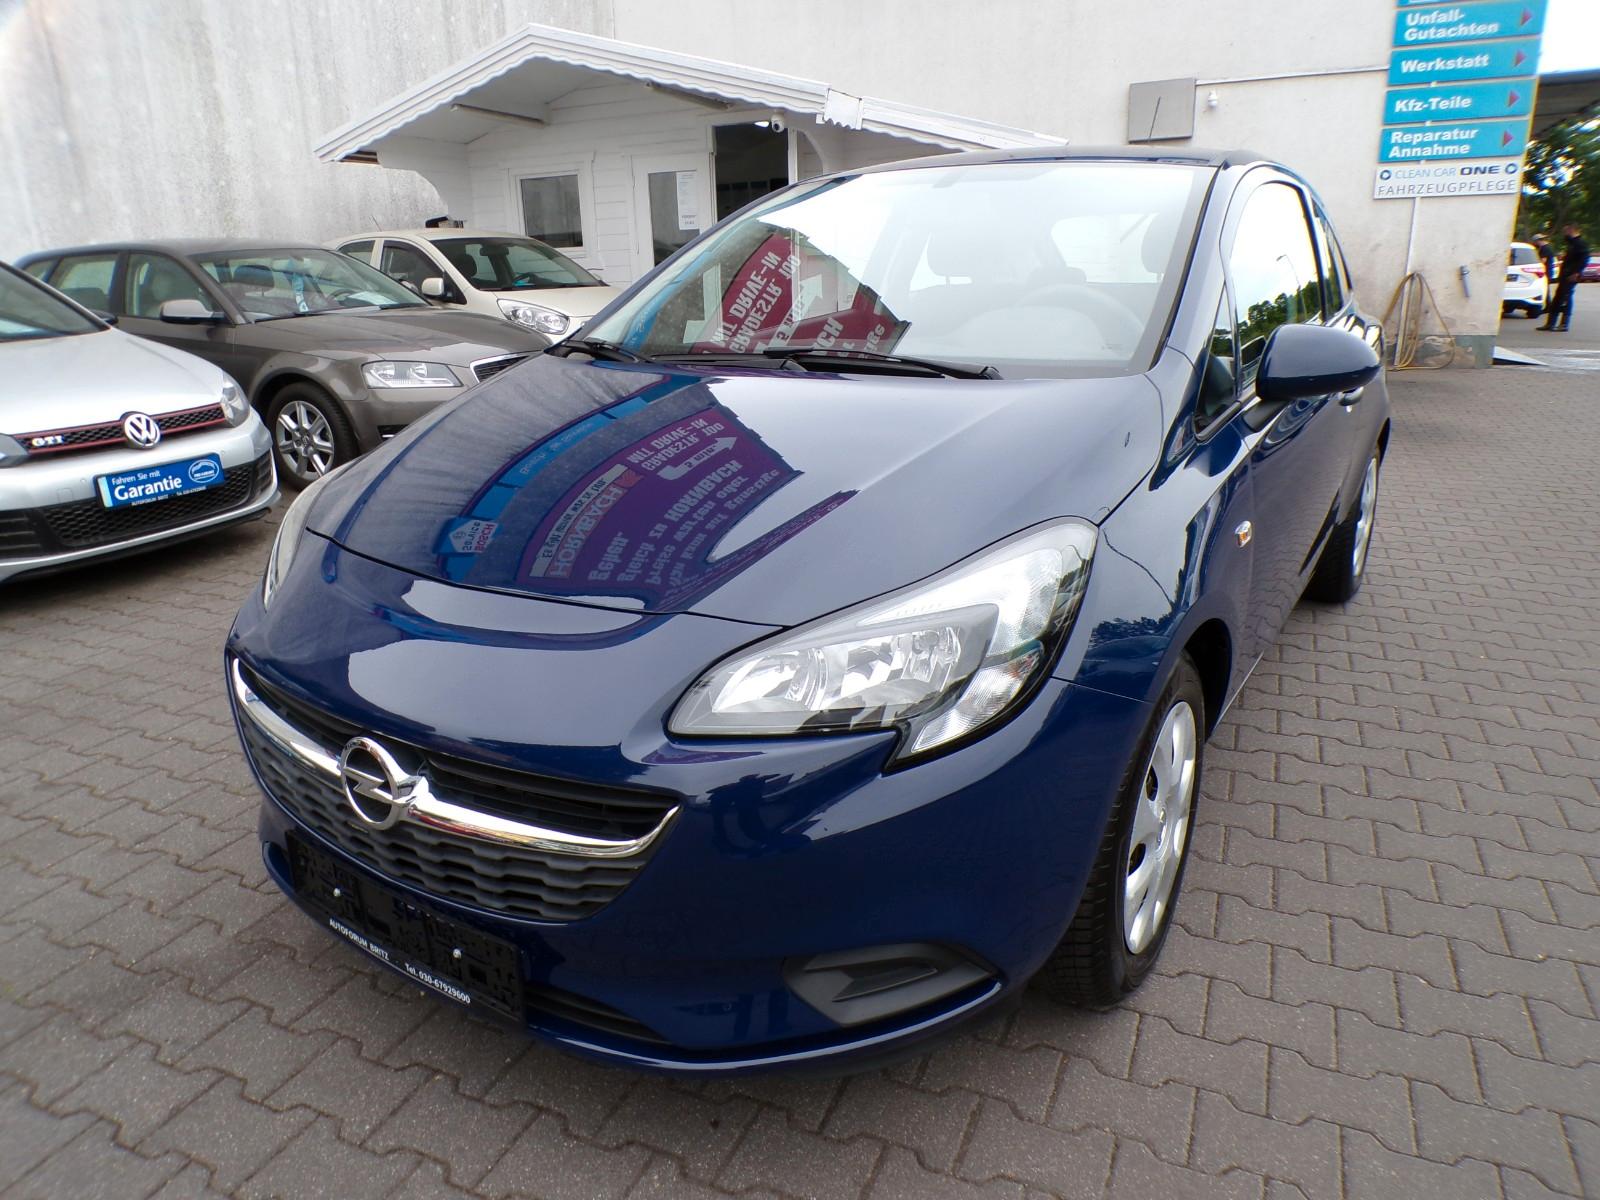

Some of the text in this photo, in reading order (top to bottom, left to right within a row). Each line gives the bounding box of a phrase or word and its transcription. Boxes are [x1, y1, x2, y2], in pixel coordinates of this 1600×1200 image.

[1406, 9, 1465, 26] Unfall-
[1404, 22, 1498, 41] Gutachten
[1401, 54, 1490, 73] Werkstatt
[1395, 96, 1472, 112] Kfz-Teile
[1391, 127, 1479, 145] Reparatur
[1388, 143, 1470, 158] Annahme
[1395, 165, 1501, 179] CLEAN CAR ONE
[1378, 179, 1516, 196] FAHRZEUGPFLEGE
[31, 435, 64, 448] GTI
[112, 470, 161, 486] Fahren Sie mit
[114, 475, 182, 500] Garantie
[329, 918, 471, 1004] AUTOFORUM BRITZ Tel. 030-67929600
